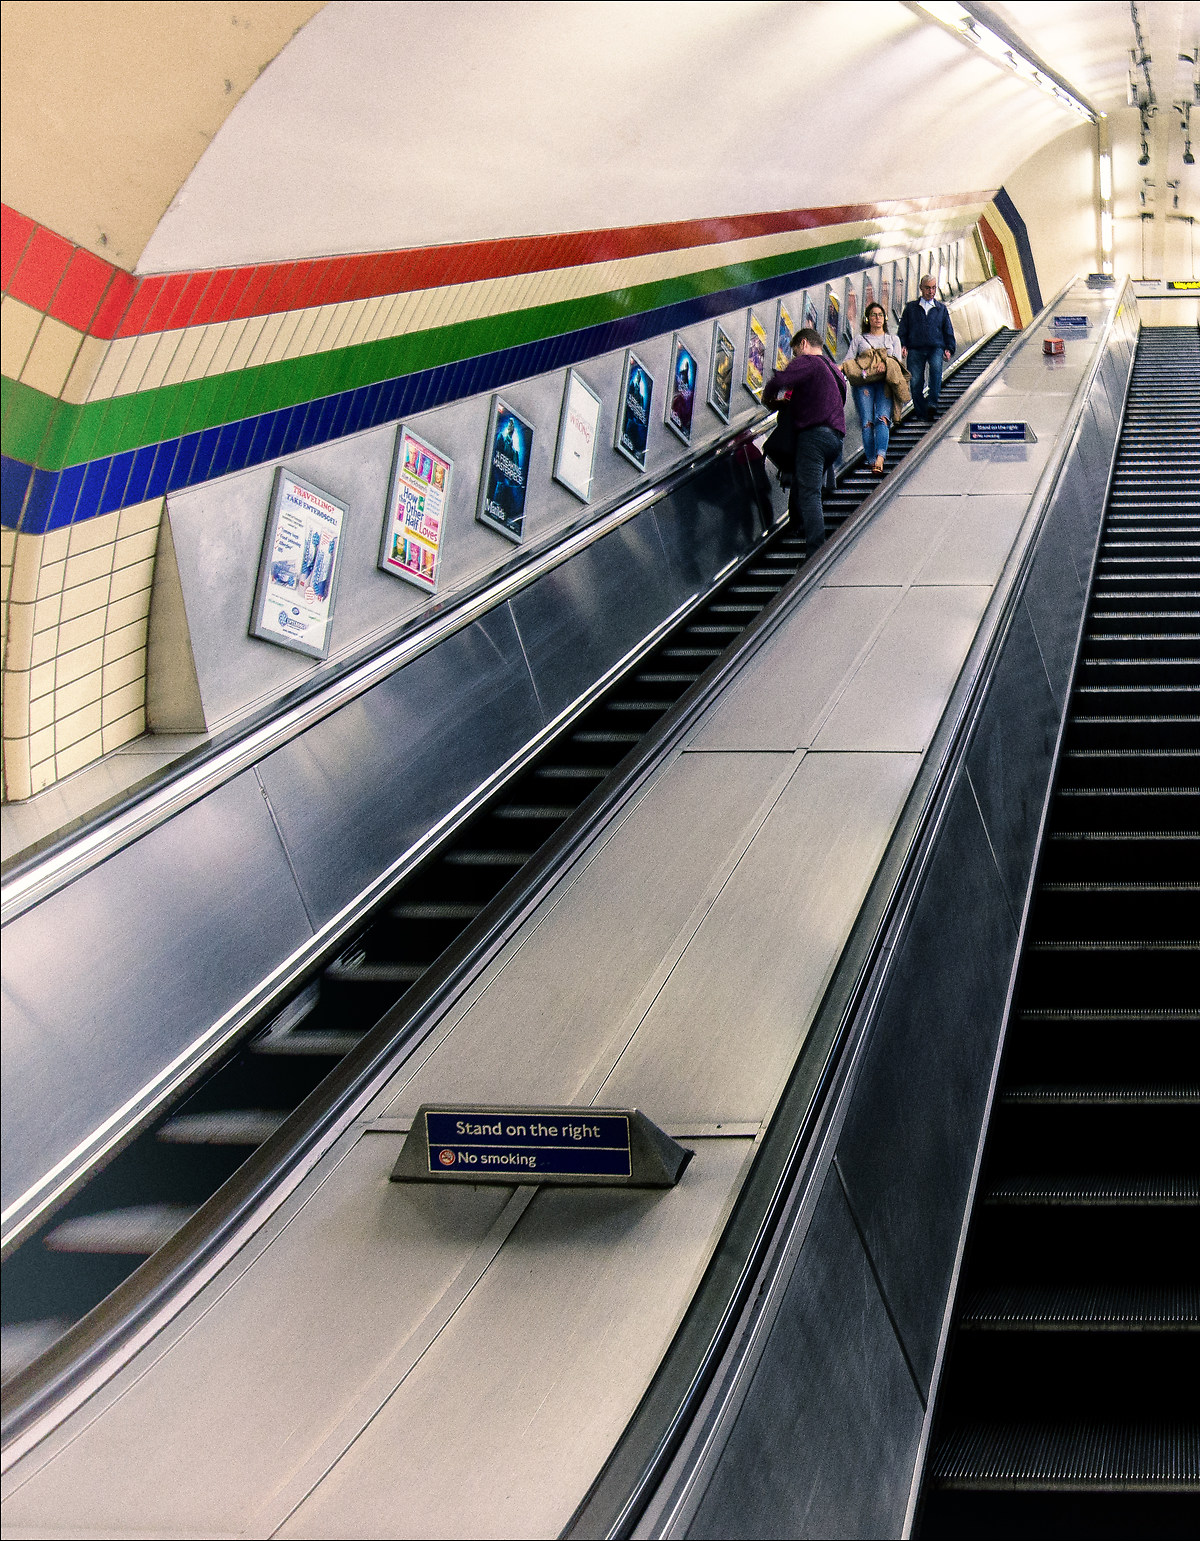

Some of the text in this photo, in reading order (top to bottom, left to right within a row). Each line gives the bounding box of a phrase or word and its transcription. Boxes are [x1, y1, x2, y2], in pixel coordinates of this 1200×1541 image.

[286, 494, 302, 507] TAKE
[293, 485, 335, 514] TRAVELLING?
[404, 486, 418, 504] How
[406, 501, 424, 521] Other
[405, 513, 419, 531] Half
[419, 522, 437, 542] Loves
[456, 1121, 601, 1141] Stand on the right
[458, 1152, 537, 1168] No smoking
